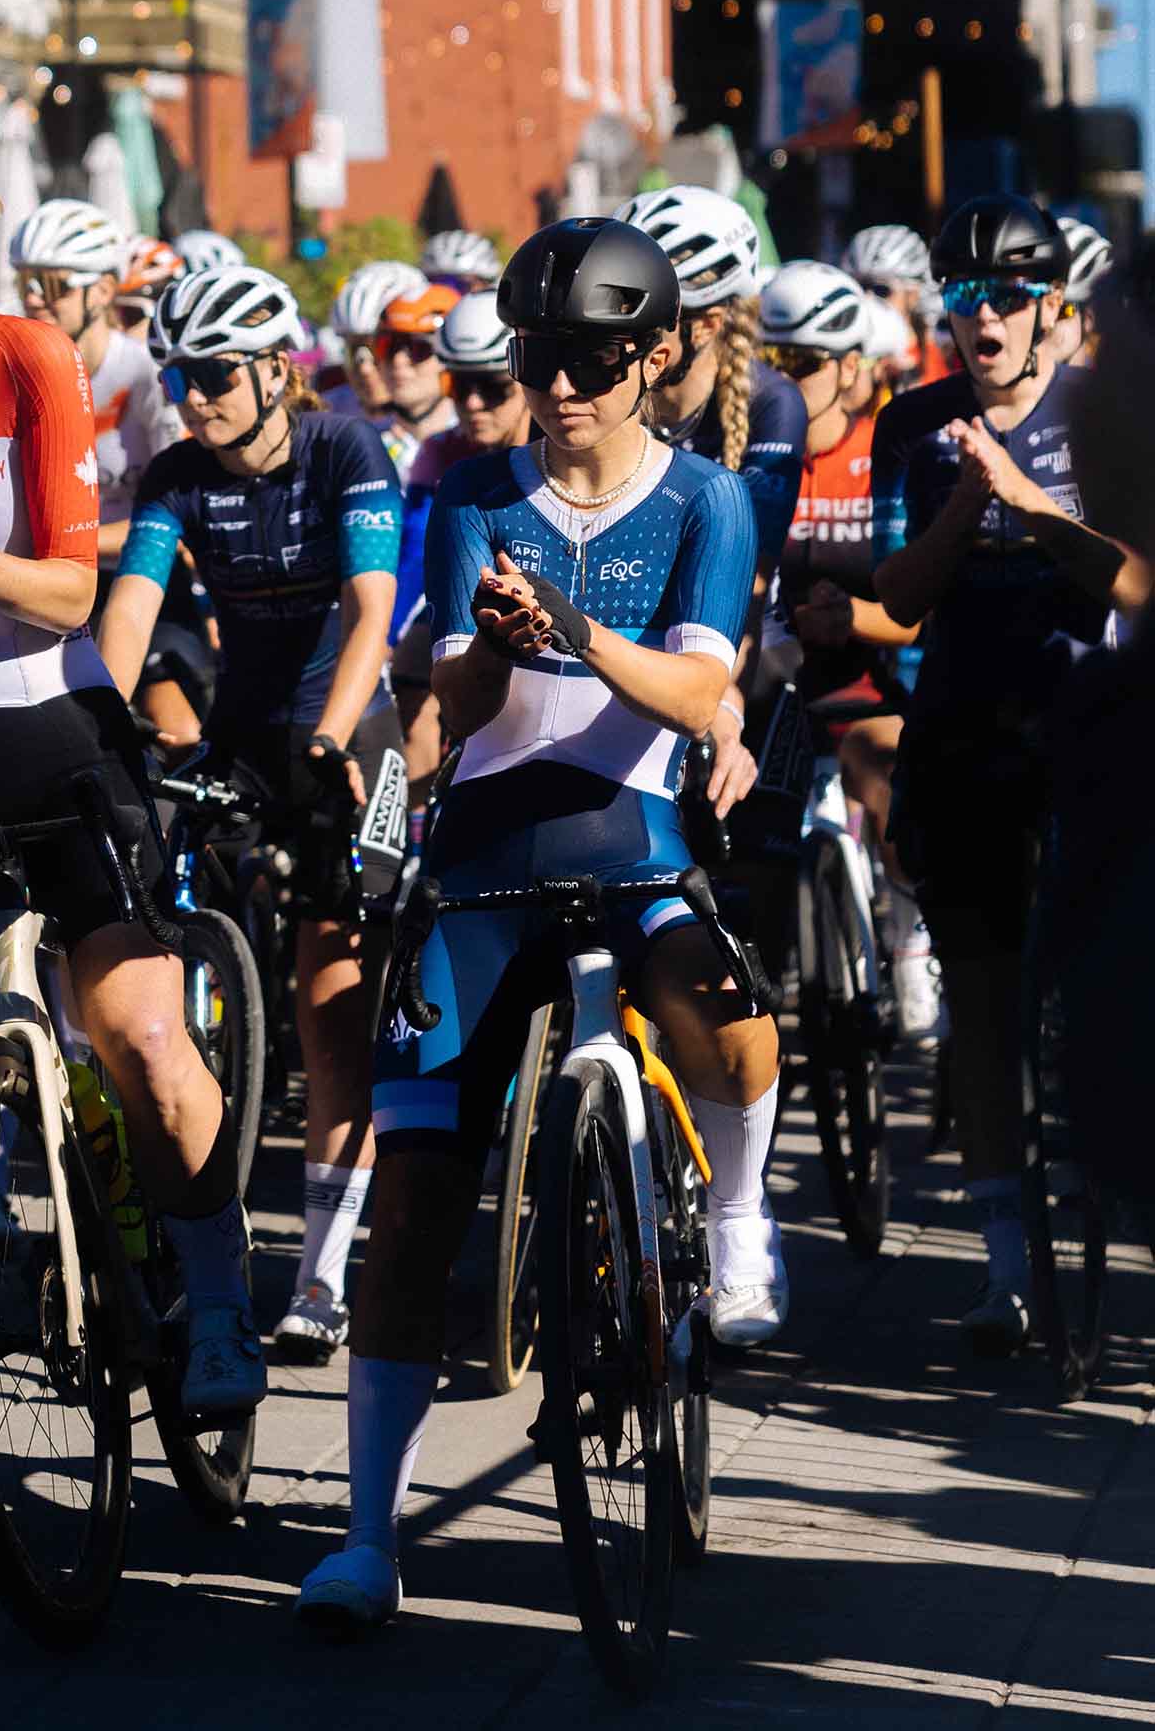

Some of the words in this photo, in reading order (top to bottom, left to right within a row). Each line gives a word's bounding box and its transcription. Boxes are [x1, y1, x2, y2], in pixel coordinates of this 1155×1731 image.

[74, 350, 91, 414] SHOKZ
[797, 497, 873, 518] TRUC
[514, 545, 540, 559] APO
